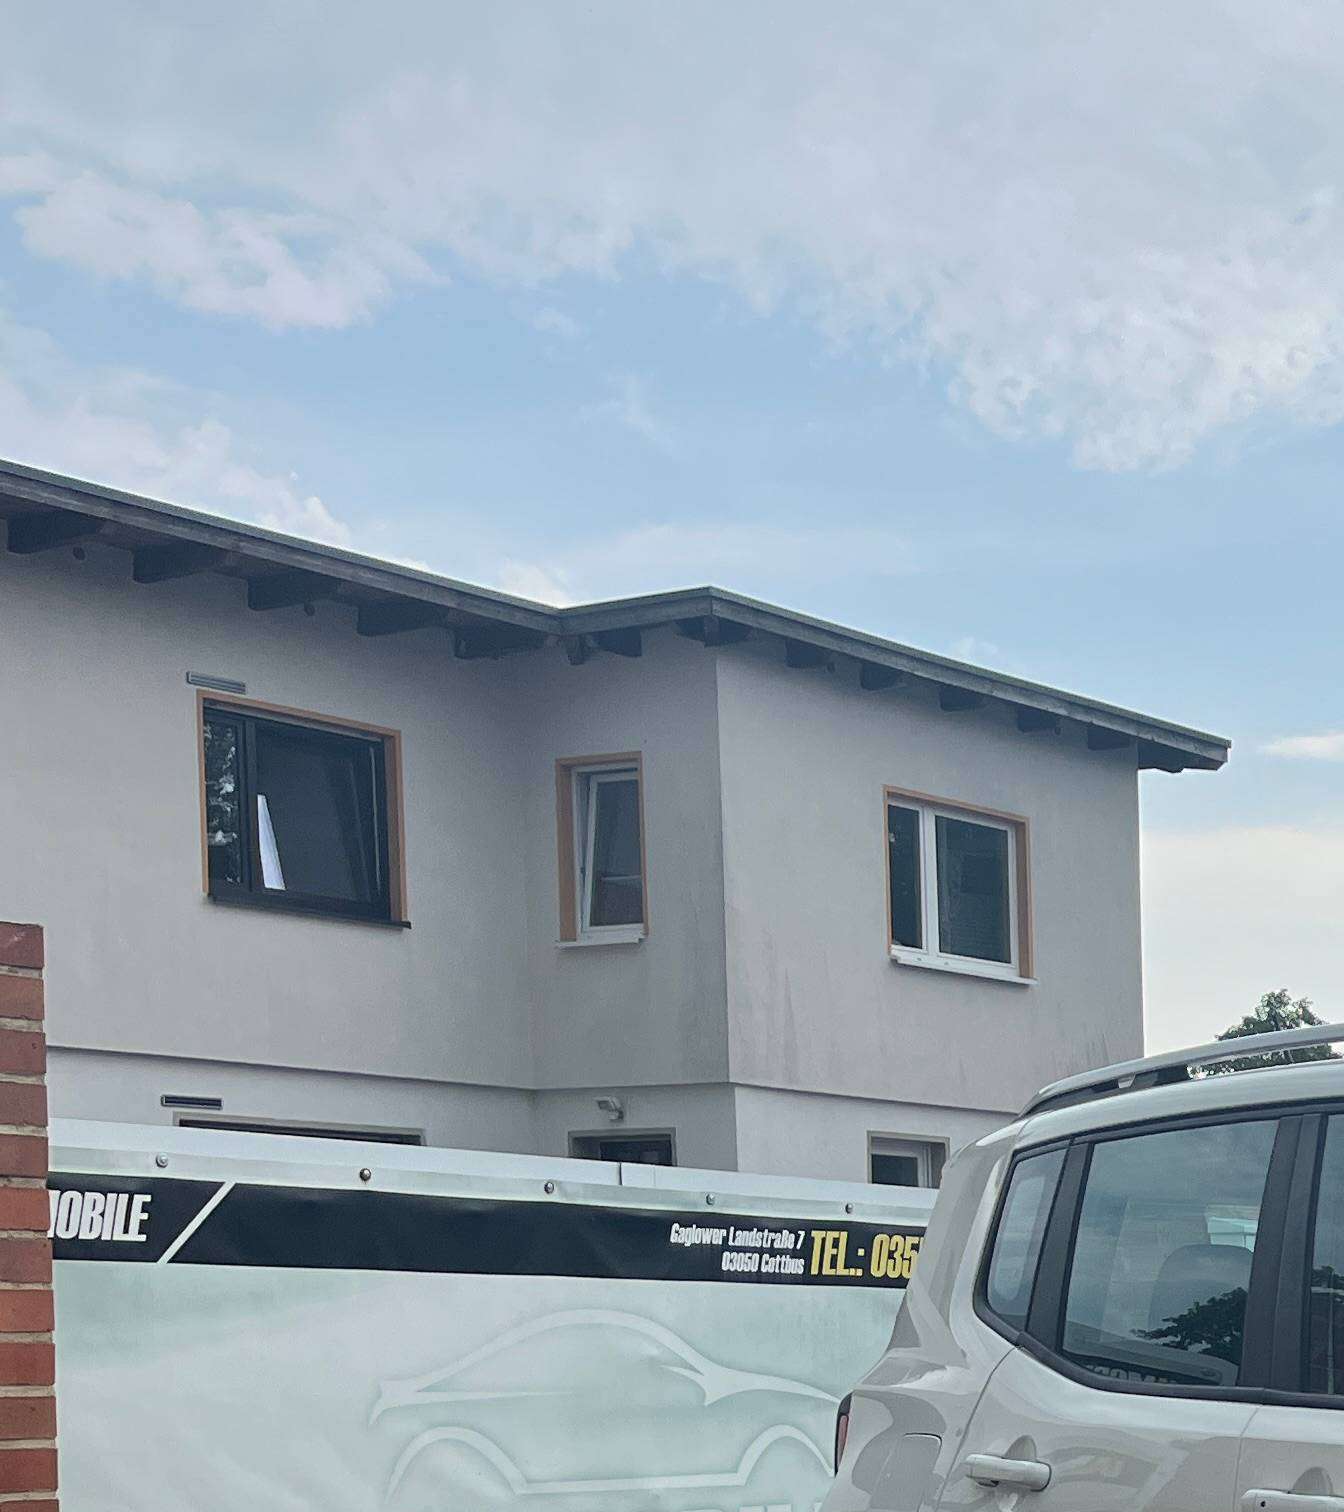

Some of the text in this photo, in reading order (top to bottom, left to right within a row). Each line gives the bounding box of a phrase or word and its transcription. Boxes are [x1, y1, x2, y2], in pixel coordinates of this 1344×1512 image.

[670, 1222, 727, 1247] Gaglower
[797, 1230, 806, 1250] 7
[721, 1251, 805, 1275] 03050 Cottbus
[811, 1229, 925, 1279] TEL.: 035
